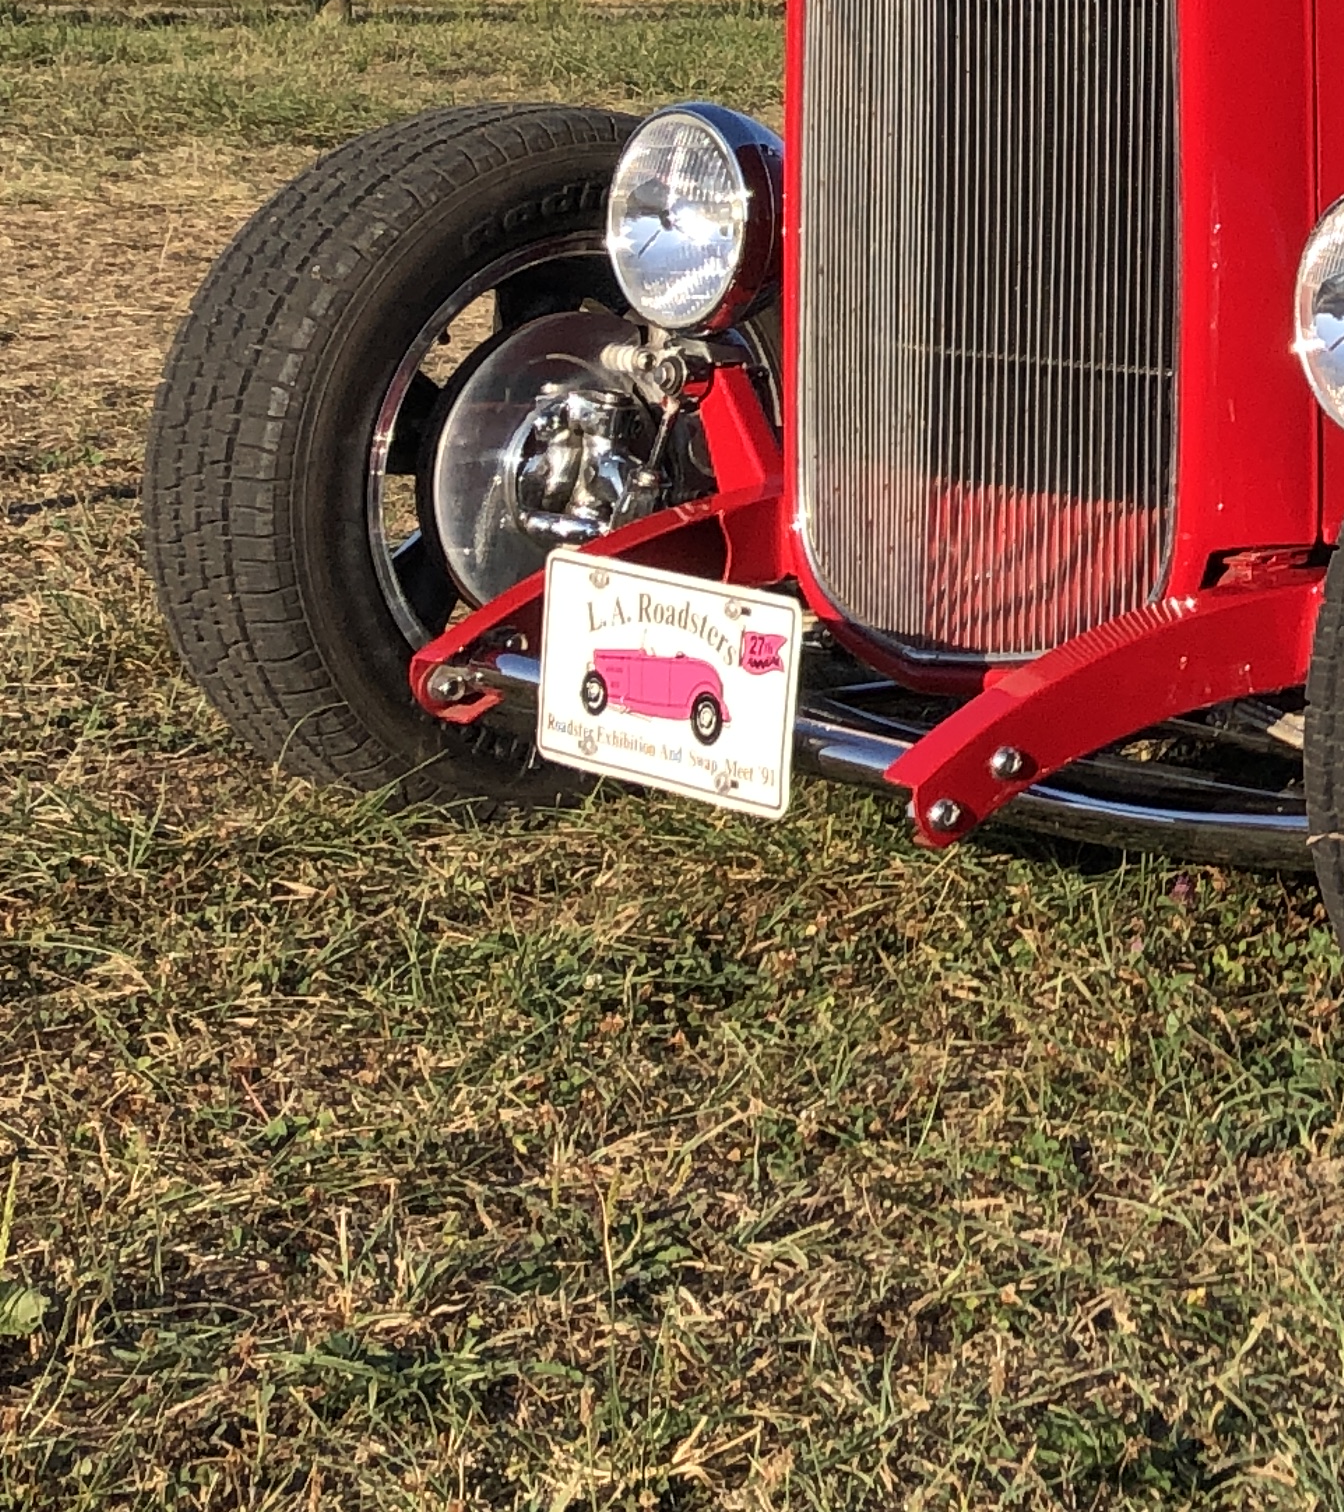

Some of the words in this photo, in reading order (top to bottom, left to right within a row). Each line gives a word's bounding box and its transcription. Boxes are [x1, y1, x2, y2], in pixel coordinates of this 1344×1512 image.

[587, 596, 632, 632] L.A.
[638, 593, 737, 666] Roadsters
[547, 713, 594, 737] Roadster
[597, 726, 655, 756] Exhibition
[661, 744, 682, 763] And
[689, 750, 718, 776] Swap
[725, 758, 753, 781] Meet
[758, 766, 775, 786] '91
